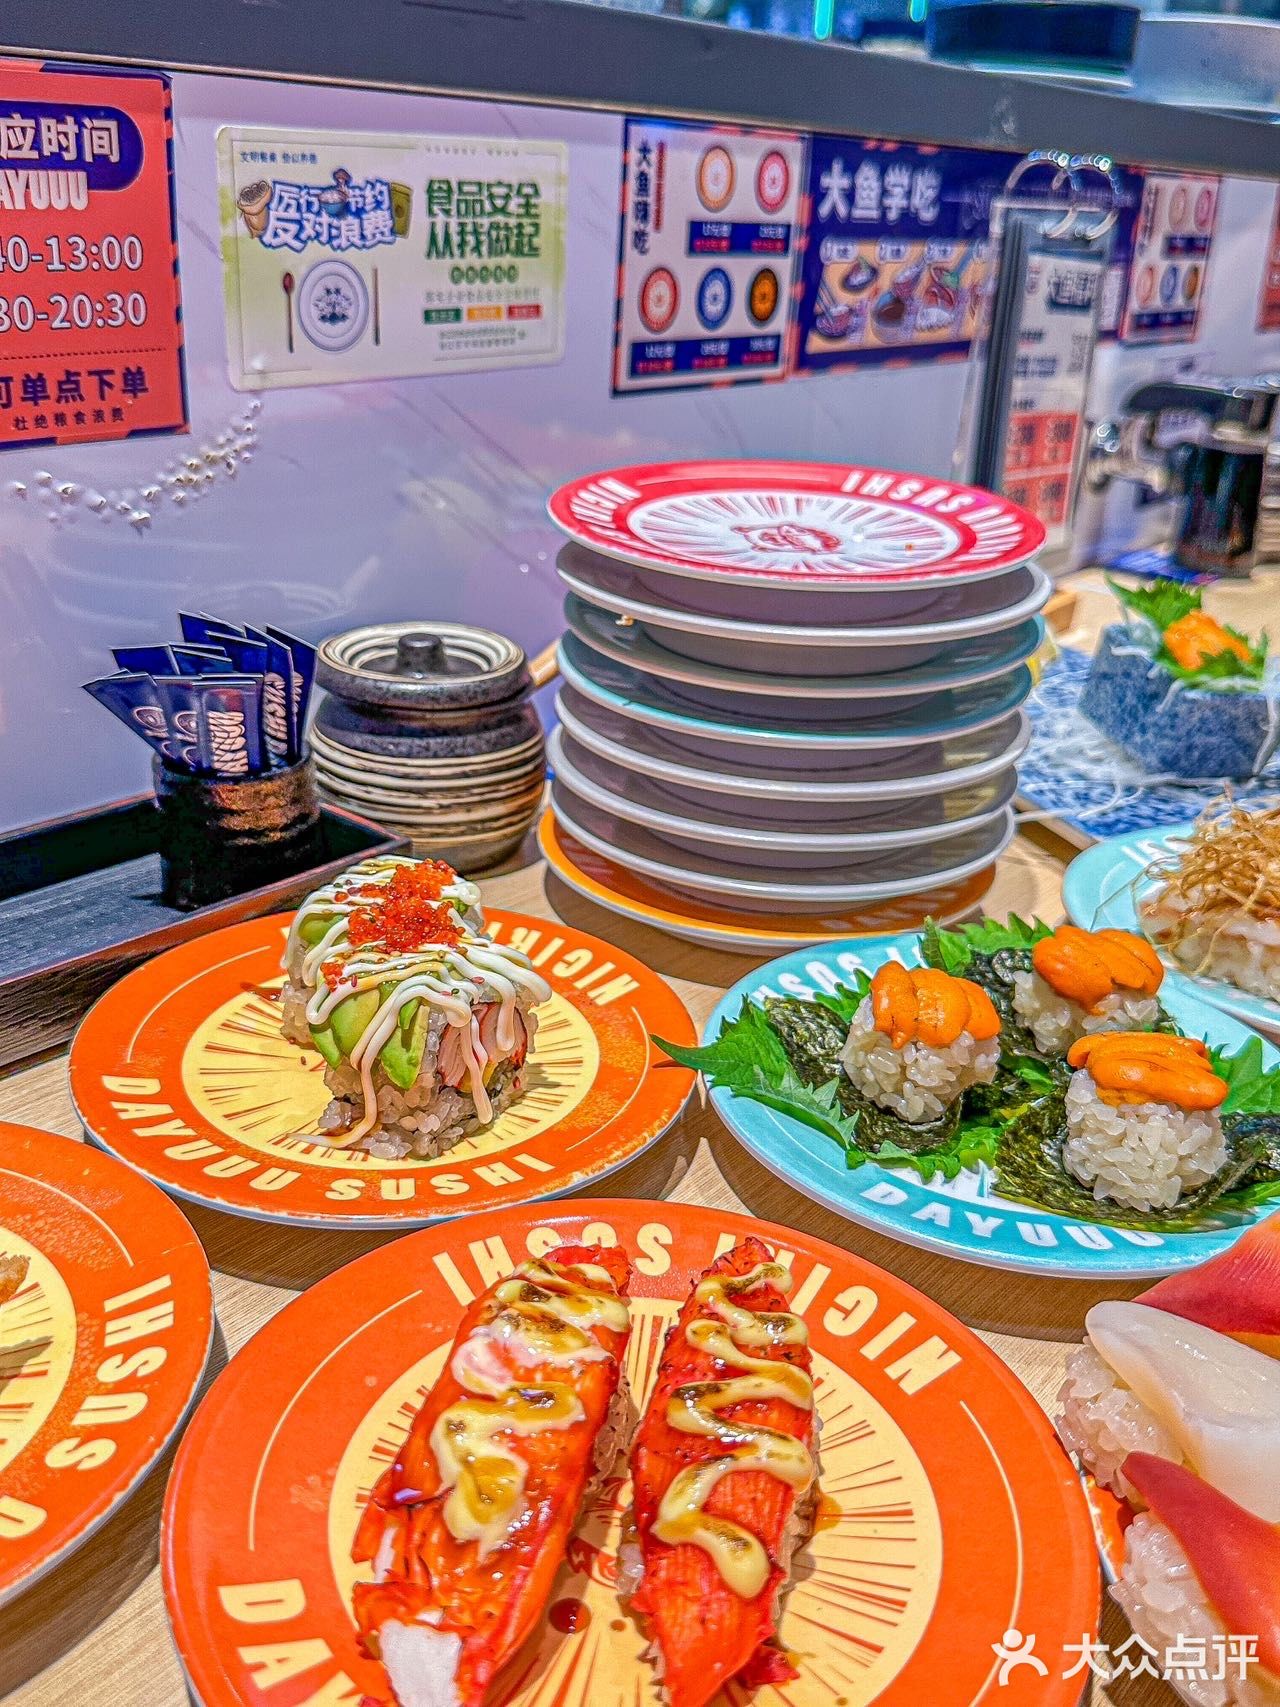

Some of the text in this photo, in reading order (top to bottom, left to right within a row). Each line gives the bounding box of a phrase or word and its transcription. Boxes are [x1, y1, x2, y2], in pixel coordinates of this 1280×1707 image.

[426, 179, 541, 218] 食品安全
[262, 210, 396, 252] 反对浪费
[426, 221, 541, 259] 从我做起
[839, 470, 977, 514] SUSHI
[101, 1075, 556, 1200] DAYUUU SUSHI
[860, 1181, 1165, 1250] DAYUUU
[45, 1273, 174, 1472] SUSHI
